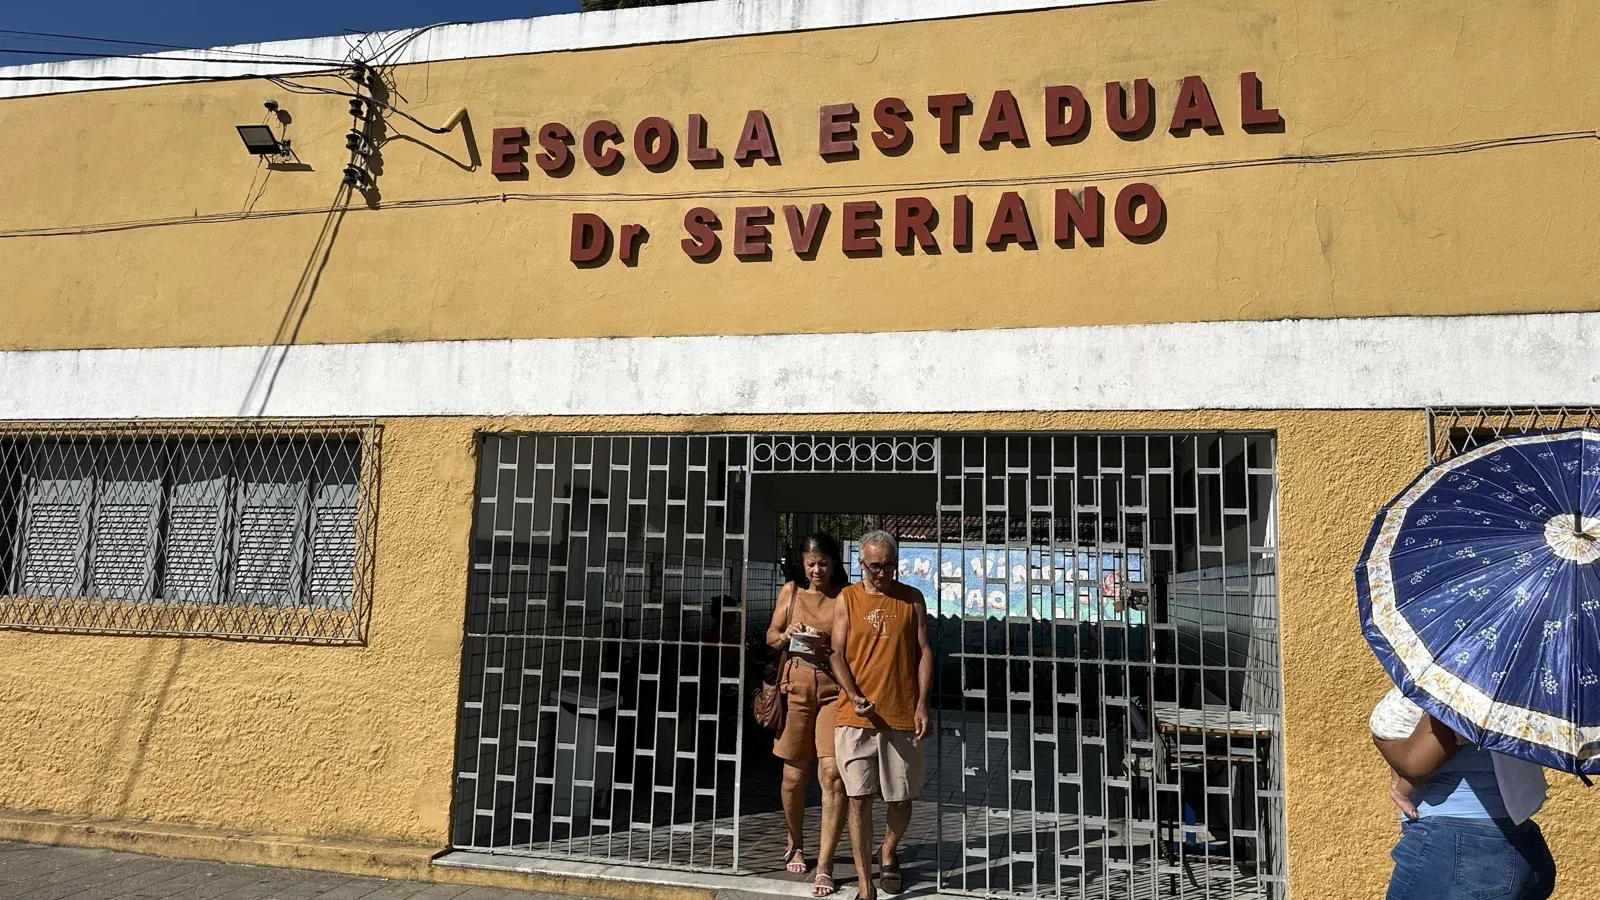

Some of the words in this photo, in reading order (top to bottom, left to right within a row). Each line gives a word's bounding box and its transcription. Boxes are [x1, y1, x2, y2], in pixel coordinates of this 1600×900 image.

[491, 109, 781, 180] ESCOLA
[819, 72, 1283, 157] ESTADUAL
[570, 212, 647, 267] Dr
[681, 183, 1165, 262] SEVERIANO
